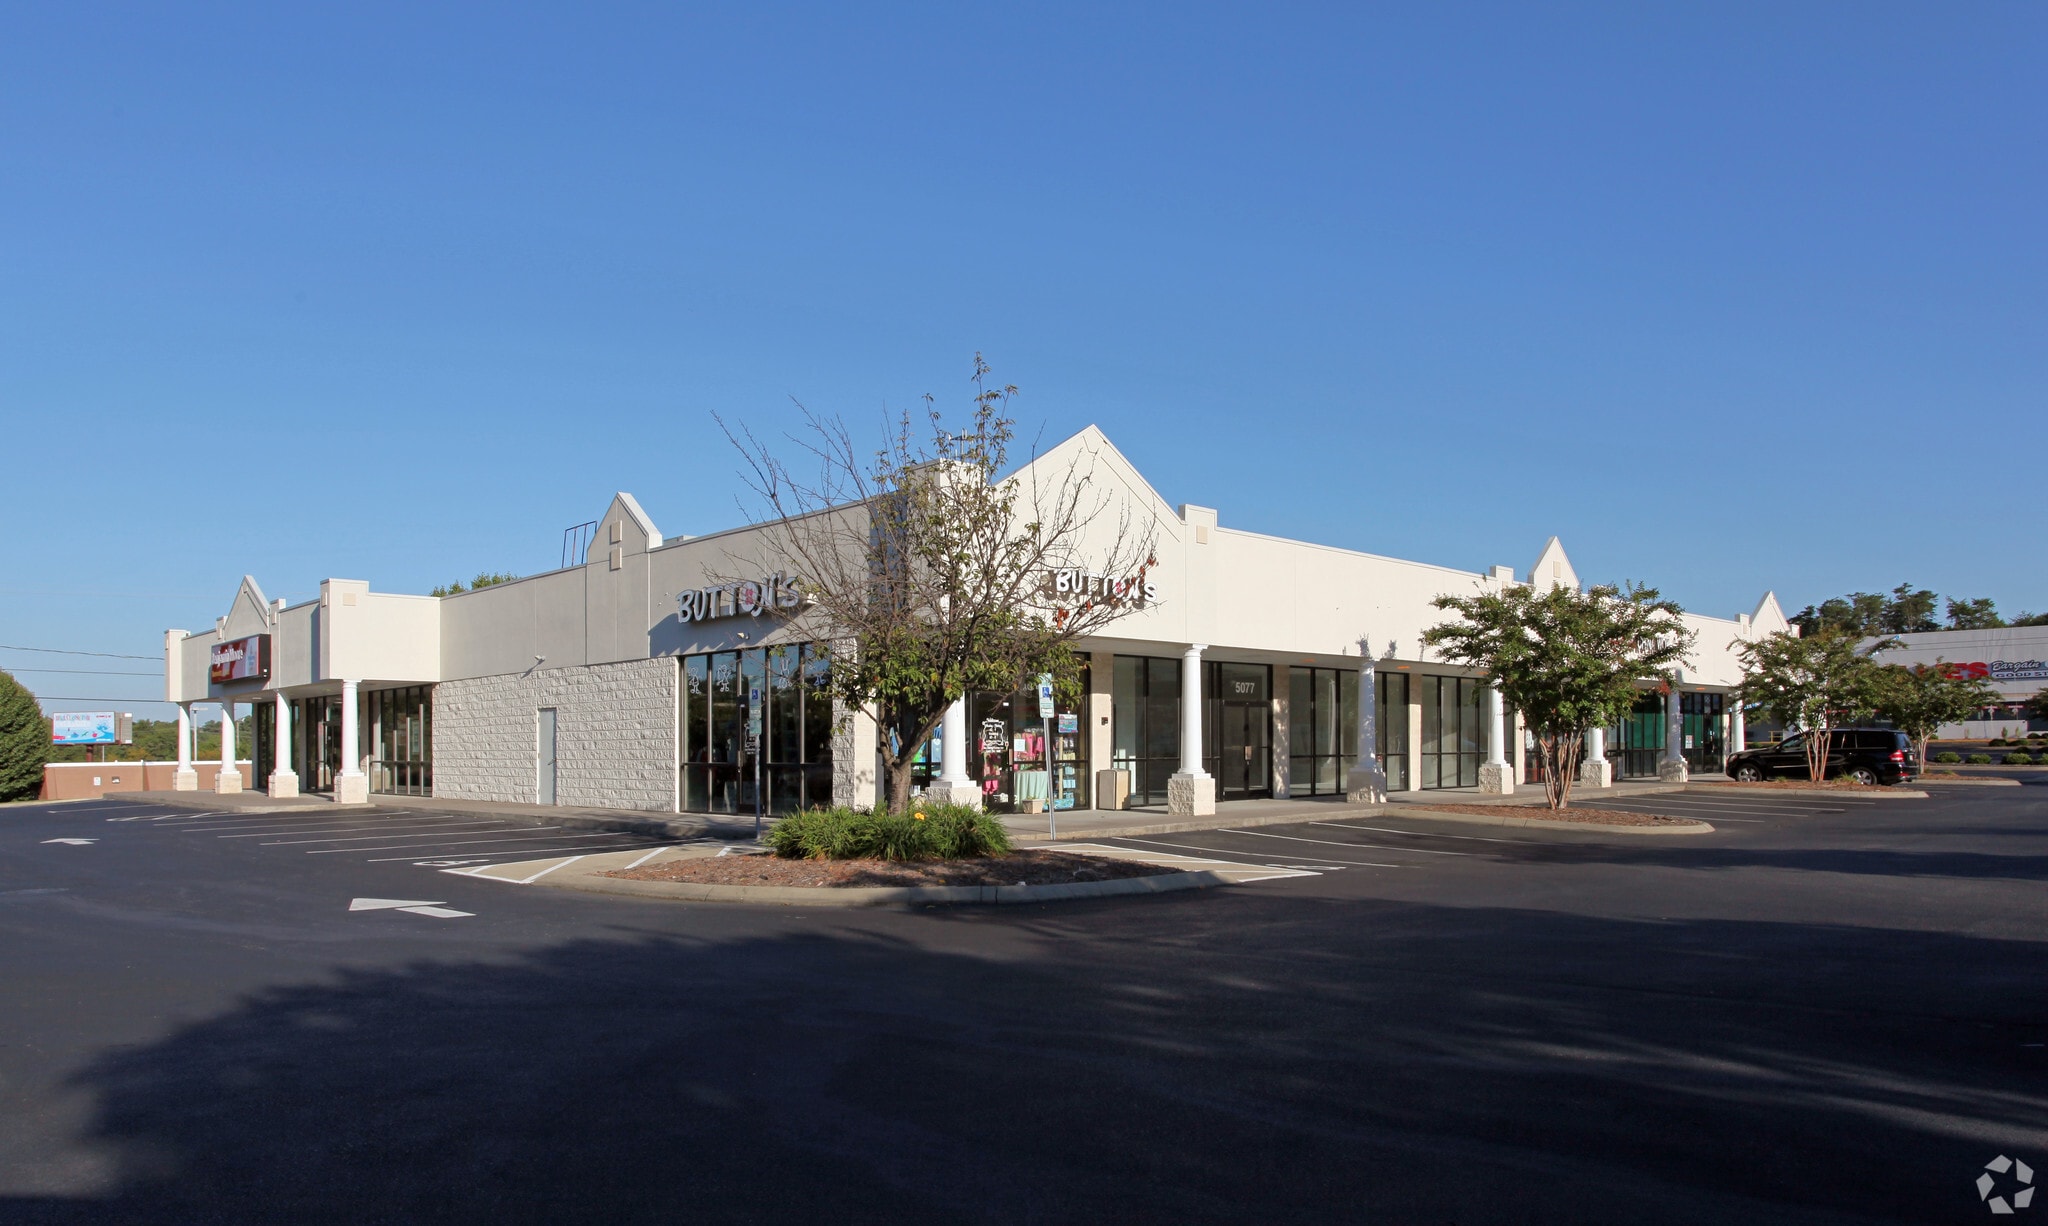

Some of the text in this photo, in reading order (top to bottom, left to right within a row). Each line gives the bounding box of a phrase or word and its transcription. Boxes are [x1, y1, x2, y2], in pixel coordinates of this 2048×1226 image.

[676, 570, 799, 623] BUTTON'S
[1053, 568, 1158, 602] BUTTONS
[1992, 660, 2040, 672] Bargain
[1235, 681, 1255, 694] 5077
